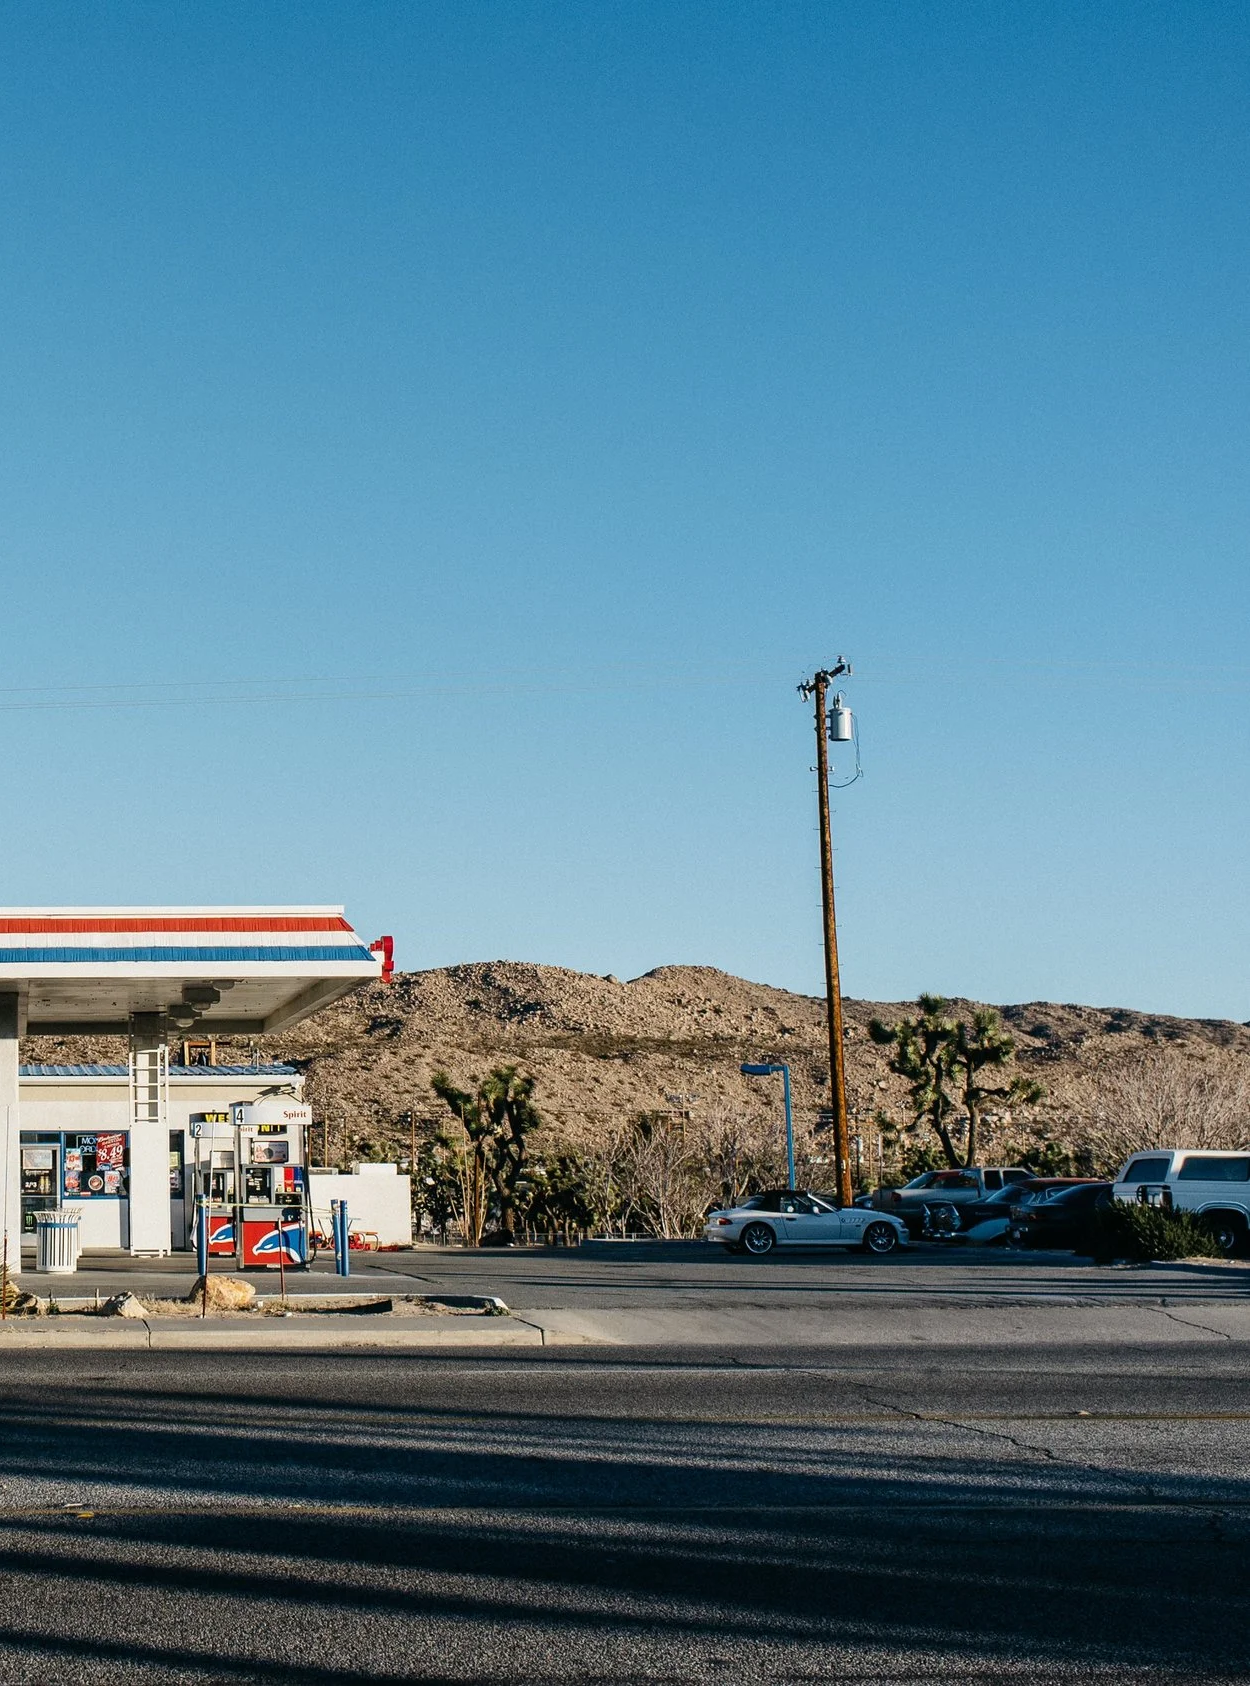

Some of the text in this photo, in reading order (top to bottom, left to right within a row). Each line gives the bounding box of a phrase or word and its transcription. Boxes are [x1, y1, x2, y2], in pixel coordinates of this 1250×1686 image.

[236, 1109, 244, 1123] 4
[283, 1111, 307, 1120] Spirit
[195, 1124, 202, 1137] 2
[98, 1145, 123, 1161] $8.49
